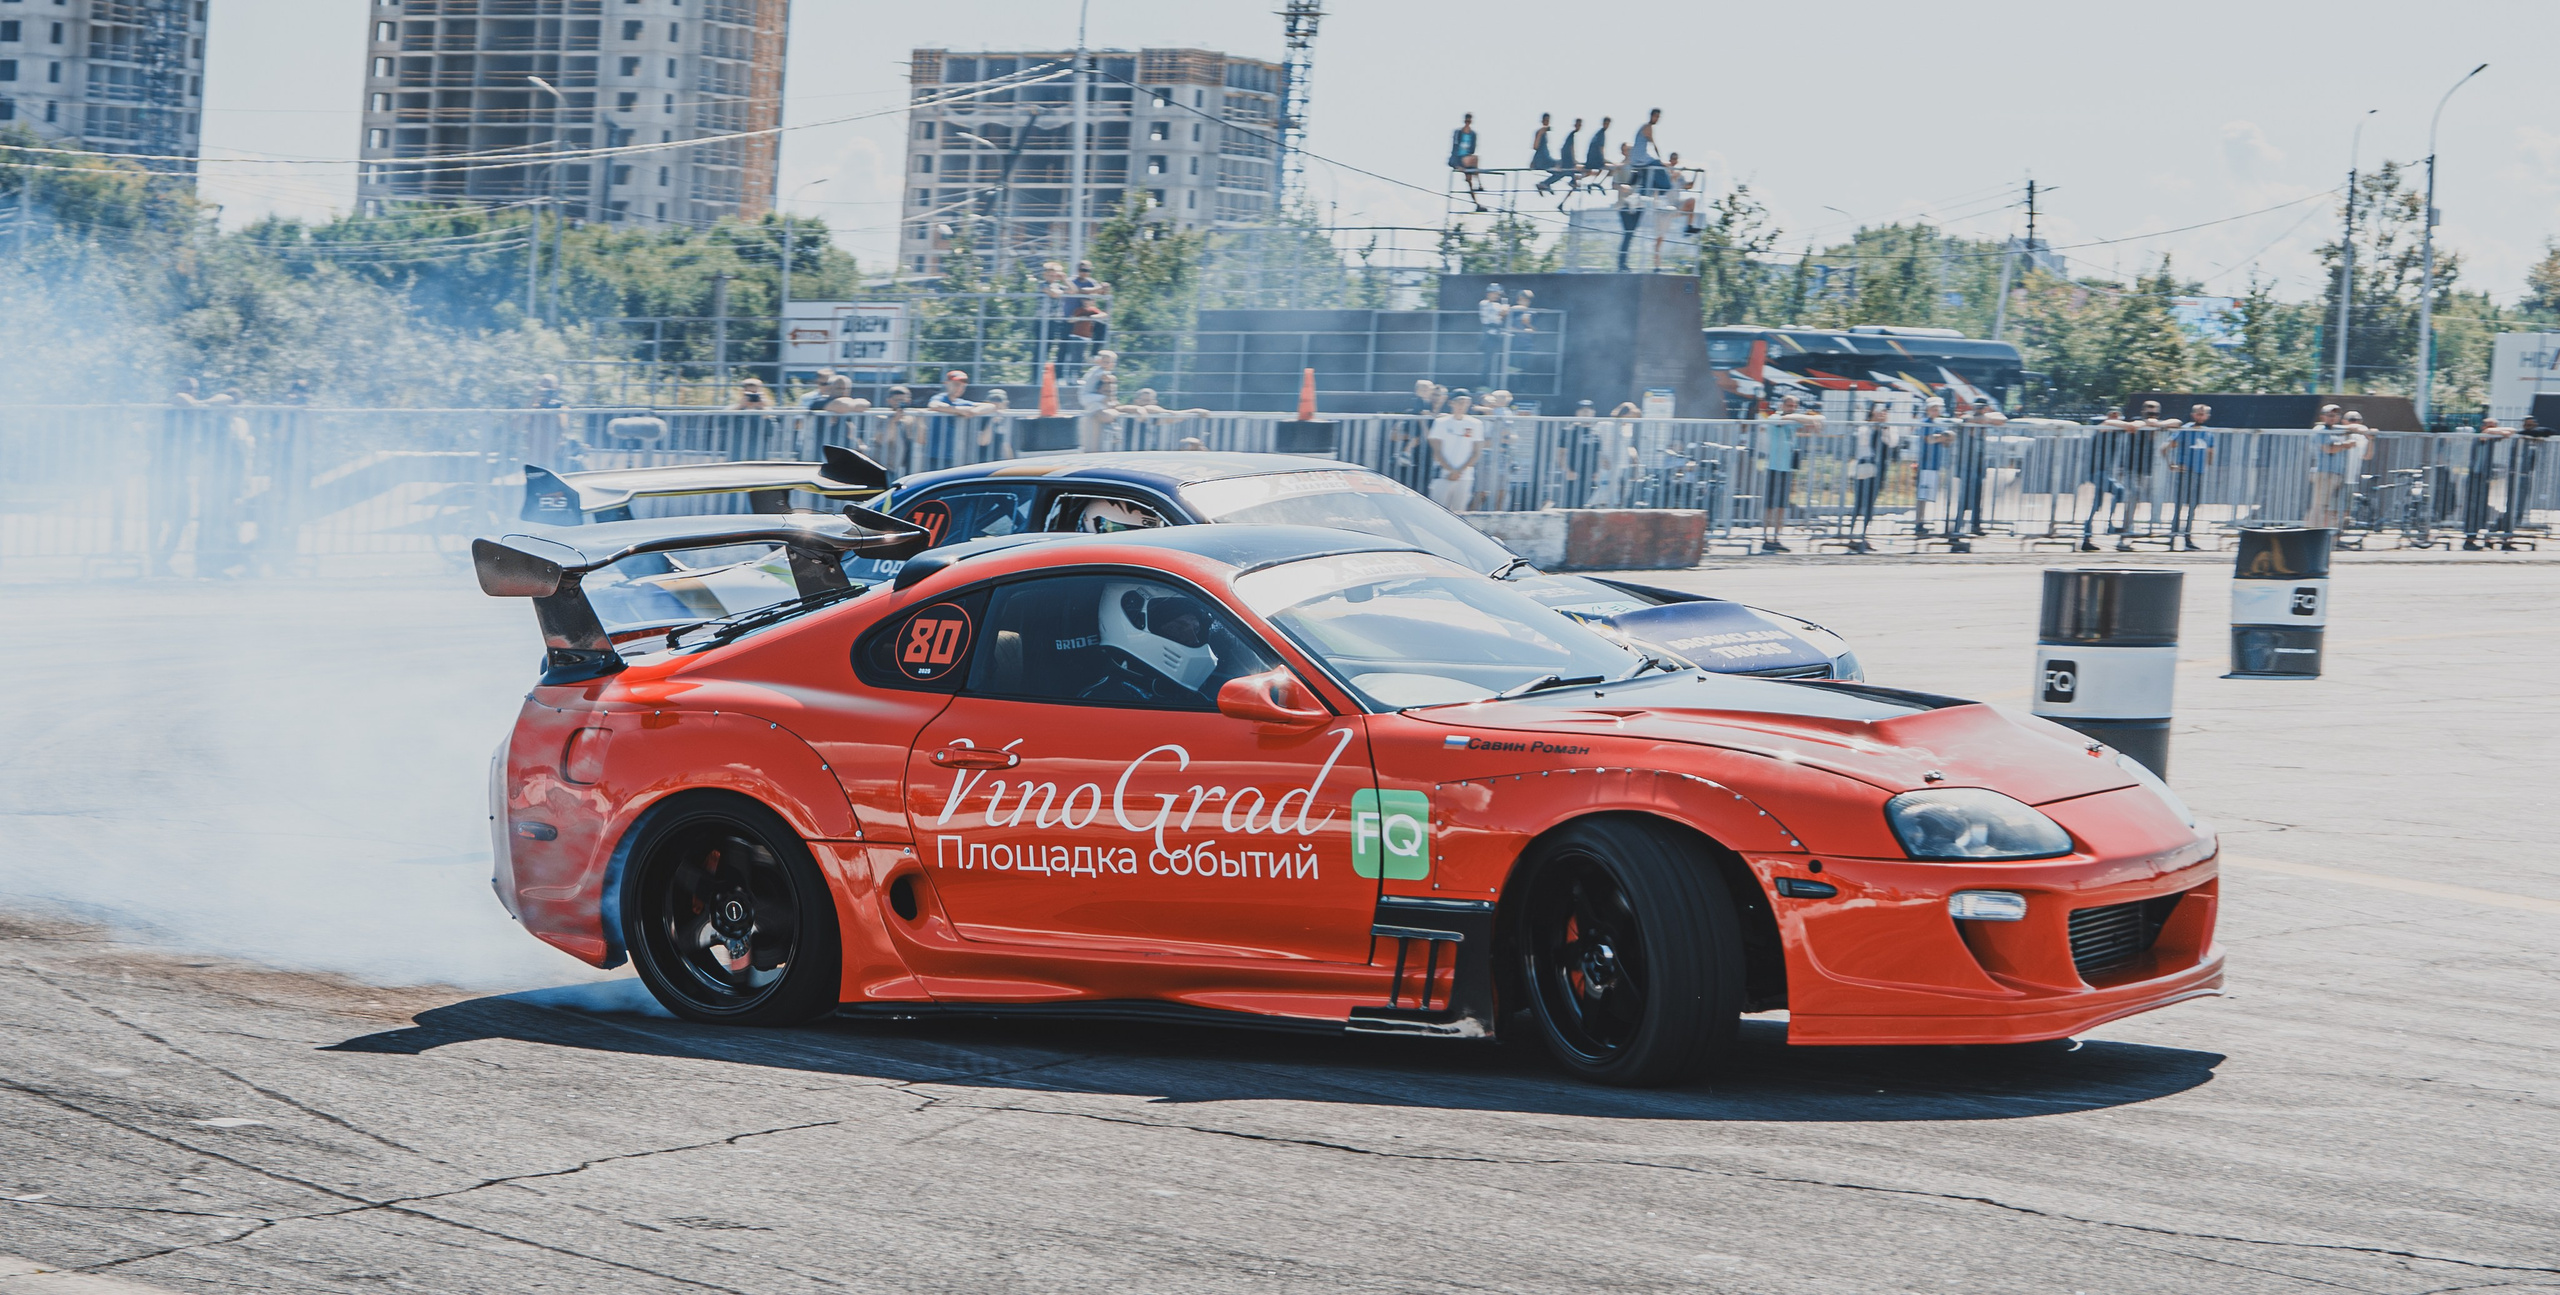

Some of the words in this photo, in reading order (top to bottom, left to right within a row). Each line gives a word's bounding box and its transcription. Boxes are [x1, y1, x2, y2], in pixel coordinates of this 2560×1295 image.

[2293, 594, 2318, 609] FQ
[903, 618, 963, 664] 80
[1055, 634, 1100, 650] BRIDE
[2044, 670, 2076, 691] FQ
[1468, 737, 1525, 752] Савин
[1530, 741, 1590, 755] Роман
[1357, 811, 1423, 857] FQ
[937, 835, 1138, 878] Площадка
[1149, 839, 1320, 880] событий
